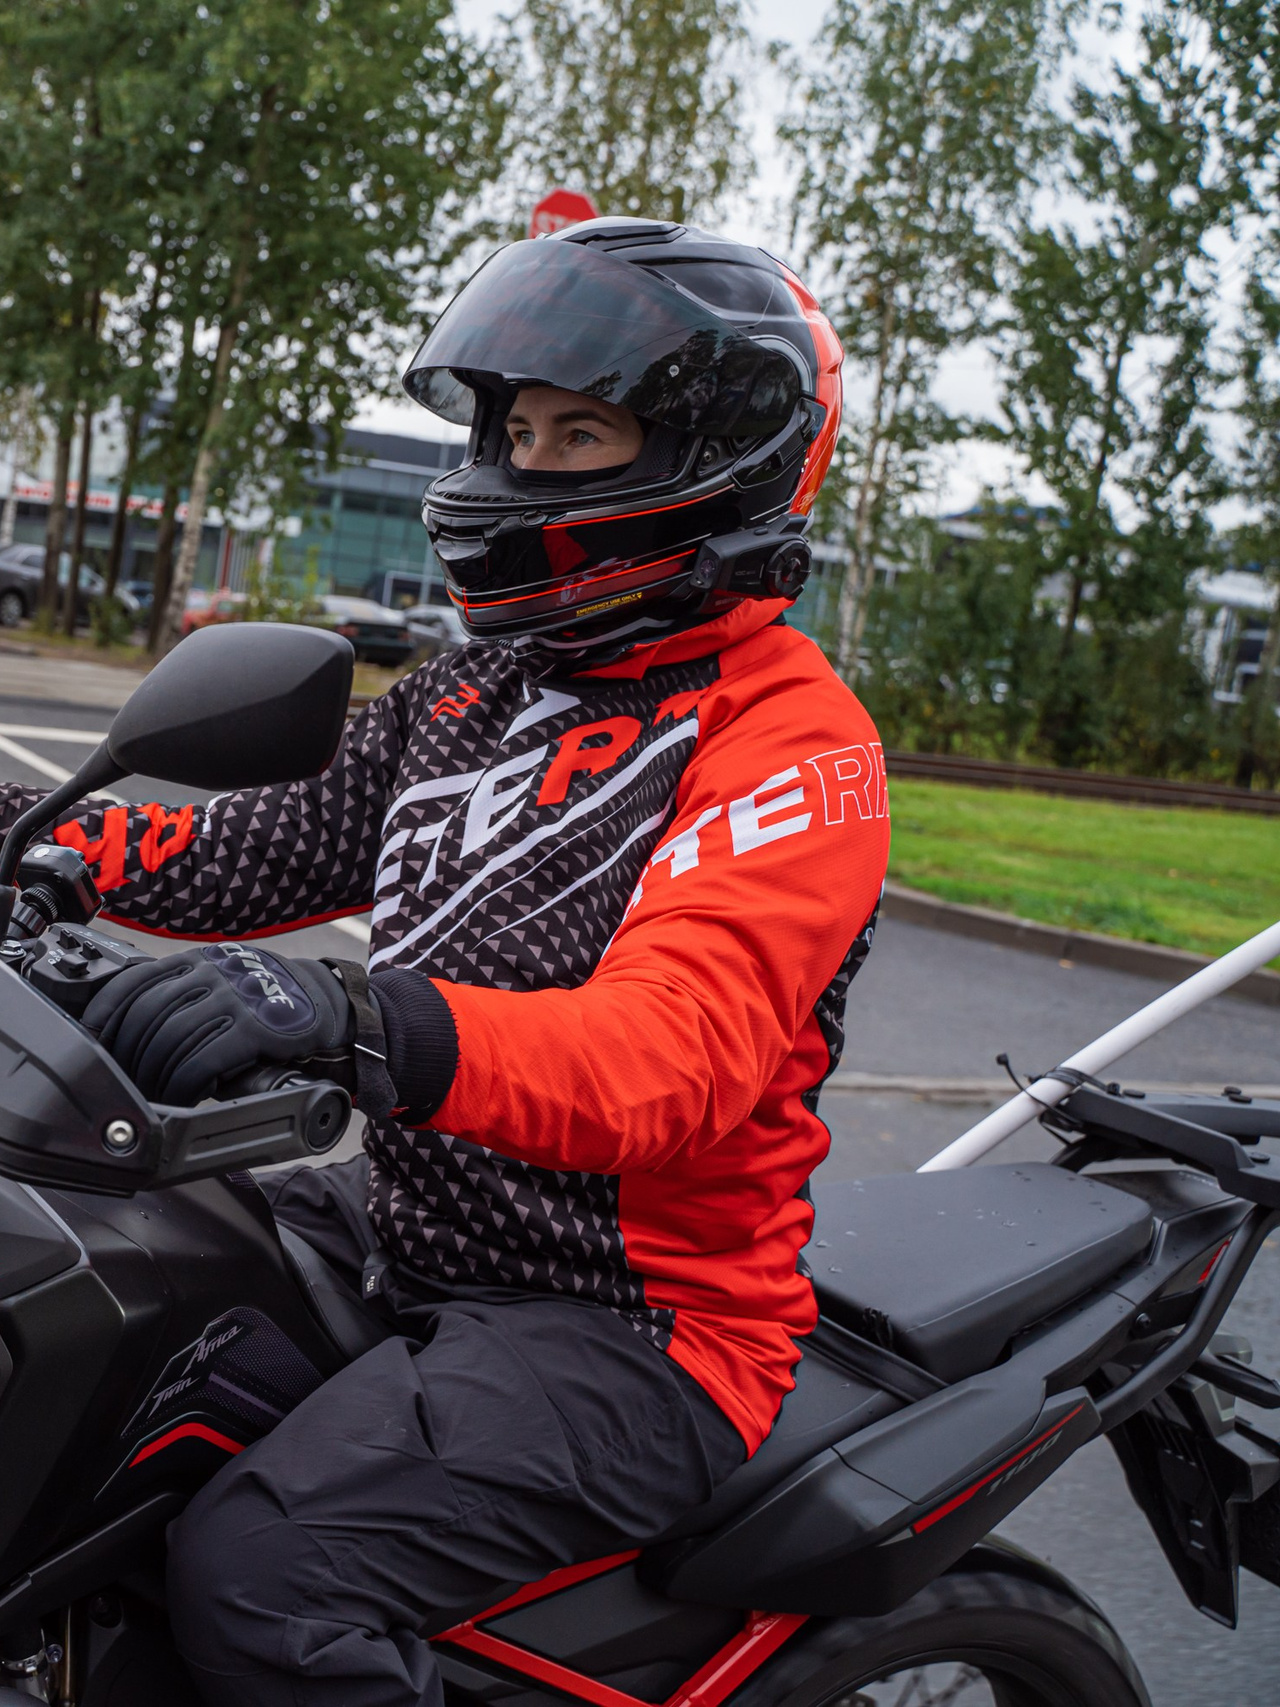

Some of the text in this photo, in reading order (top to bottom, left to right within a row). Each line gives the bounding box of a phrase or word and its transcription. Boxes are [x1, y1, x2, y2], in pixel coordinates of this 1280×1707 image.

[576, 602, 609, 614] EMERGENCY
[621, 593, 637, 603] ONLY
[181, 1325, 244, 1378] Africa
[147, 1377, 200, 1419] Twin
